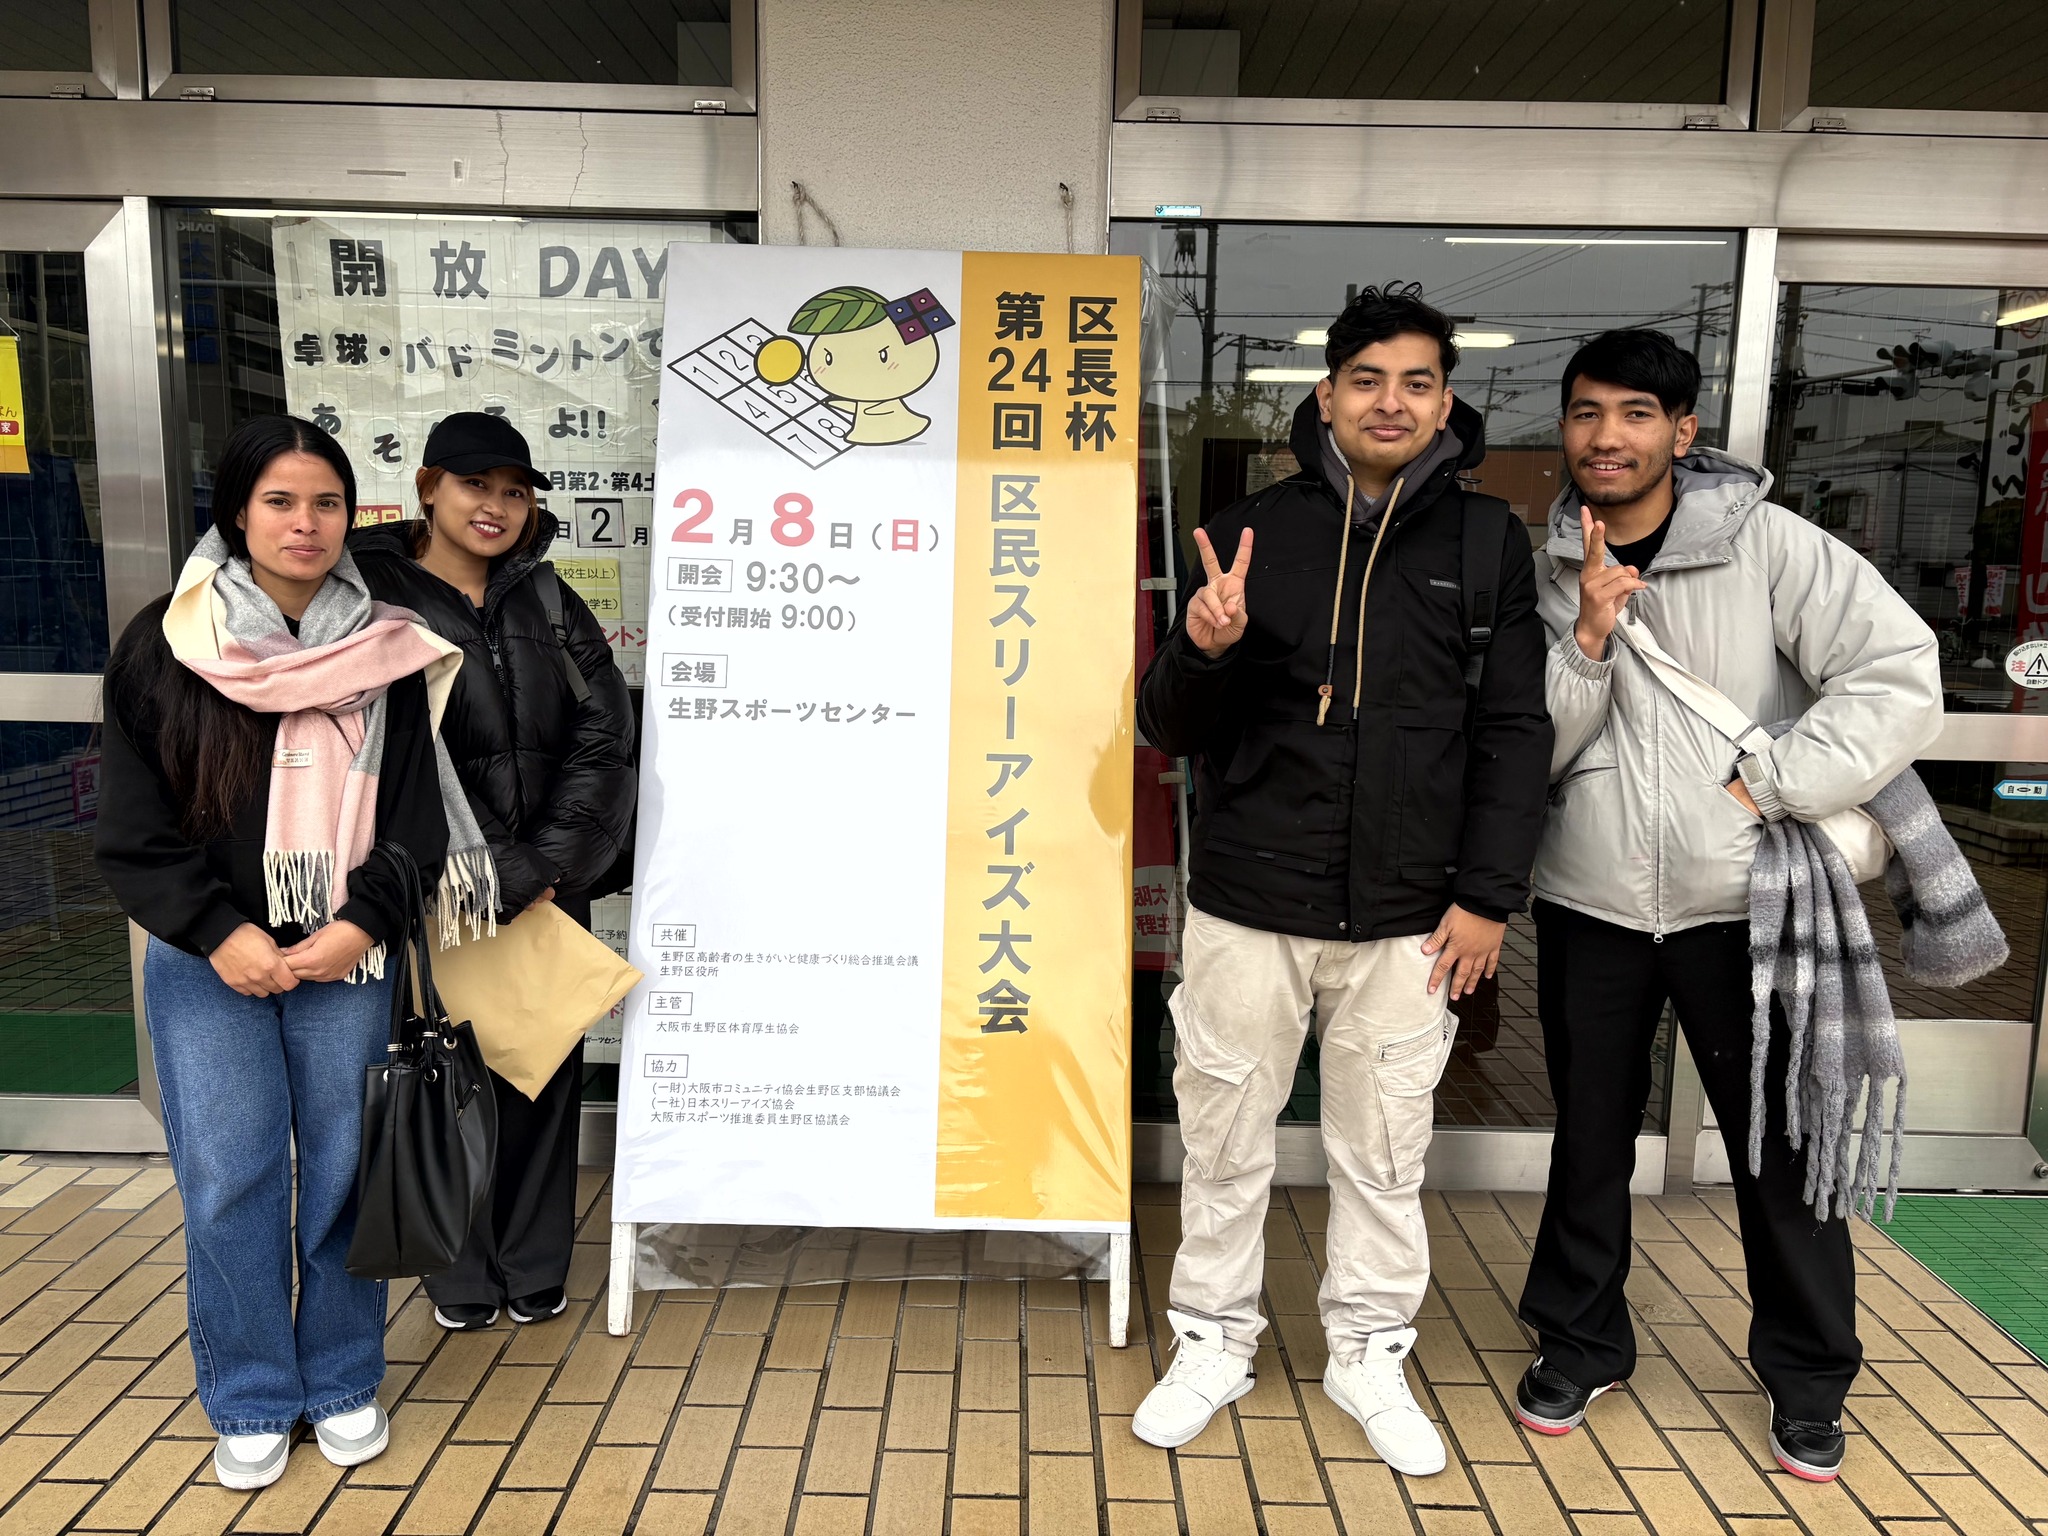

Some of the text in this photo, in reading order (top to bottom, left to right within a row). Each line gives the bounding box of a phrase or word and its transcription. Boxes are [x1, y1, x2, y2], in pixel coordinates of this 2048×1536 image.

[540, 246, 668, 299] DAY
[1065, 296, 1118, 452] 区長杯
[591, 507, 612, 542] 2
[632, 527, 648, 545] 月
[678, 564, 722, 586] 開会
[977, 291, 1052, 1035] 第24回 区民スリーアイズ大会
[2011, 660, 2026, 673] 注
[671, 661, 717, 684] 会場
[668, 697, 916, 725] 生野スポーツセンター
[660, 928, 688, 942] 共催
[660, 951, 919, 967] 生野区高齢者の生きがいと健康づくり総合推進会議
[659, 966, 719, 978] 生野区役所
[655, 996, 682, 1010] 主管
[656, 1021, 800, 1035] 大阪市生野区体育厚生協会
[651, 1059, 678, 1073] 協力
[650, 1111, 851, 1126] 大阪市スポーツ推進委員生野区協議会
